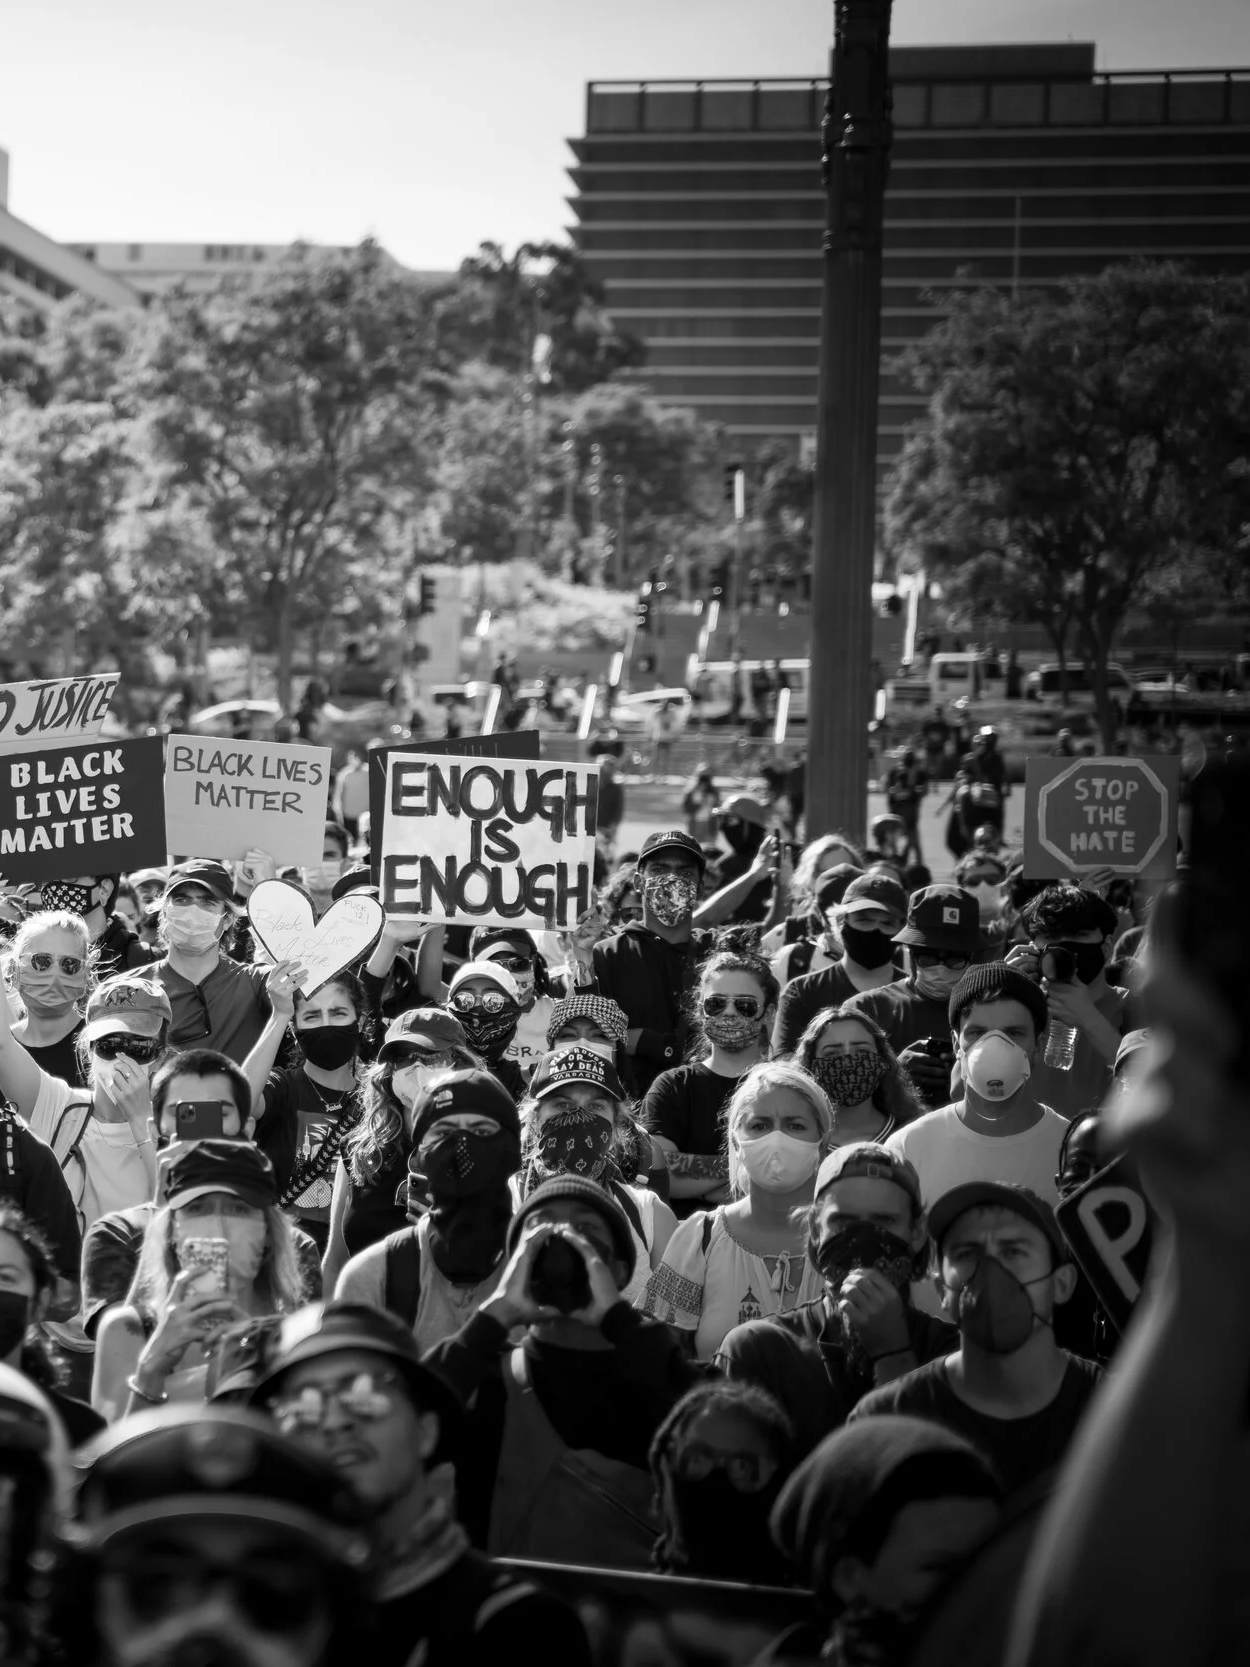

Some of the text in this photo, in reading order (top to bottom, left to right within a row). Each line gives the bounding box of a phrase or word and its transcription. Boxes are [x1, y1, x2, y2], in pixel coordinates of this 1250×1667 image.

[15, 677, 119, 736] JUSTICE
[10, 748, 125, 788] BLACK
[173, 746, 323, 786] BLACK LIVES
[16, 783, 121, 820] LIVES
[195, 780, 303, 814] MATTER
[391, 761, 599, 843] ENOUGH
[1075, 778, 1139, 801] STOP
[0, 812, 135, 855] MATTER
[1082, 805, 1126, 825] THE
[470, 817, 520, 863] IS
[1070, 831, 1135, 853] HATE
[383, 855, 590, 930] ENOUGH
[550, 1061, 605, 1076] PLAY DEAD
[568, 1053, 584, 1061] OR
[573, 1047, 605, 1068] ROUGH
